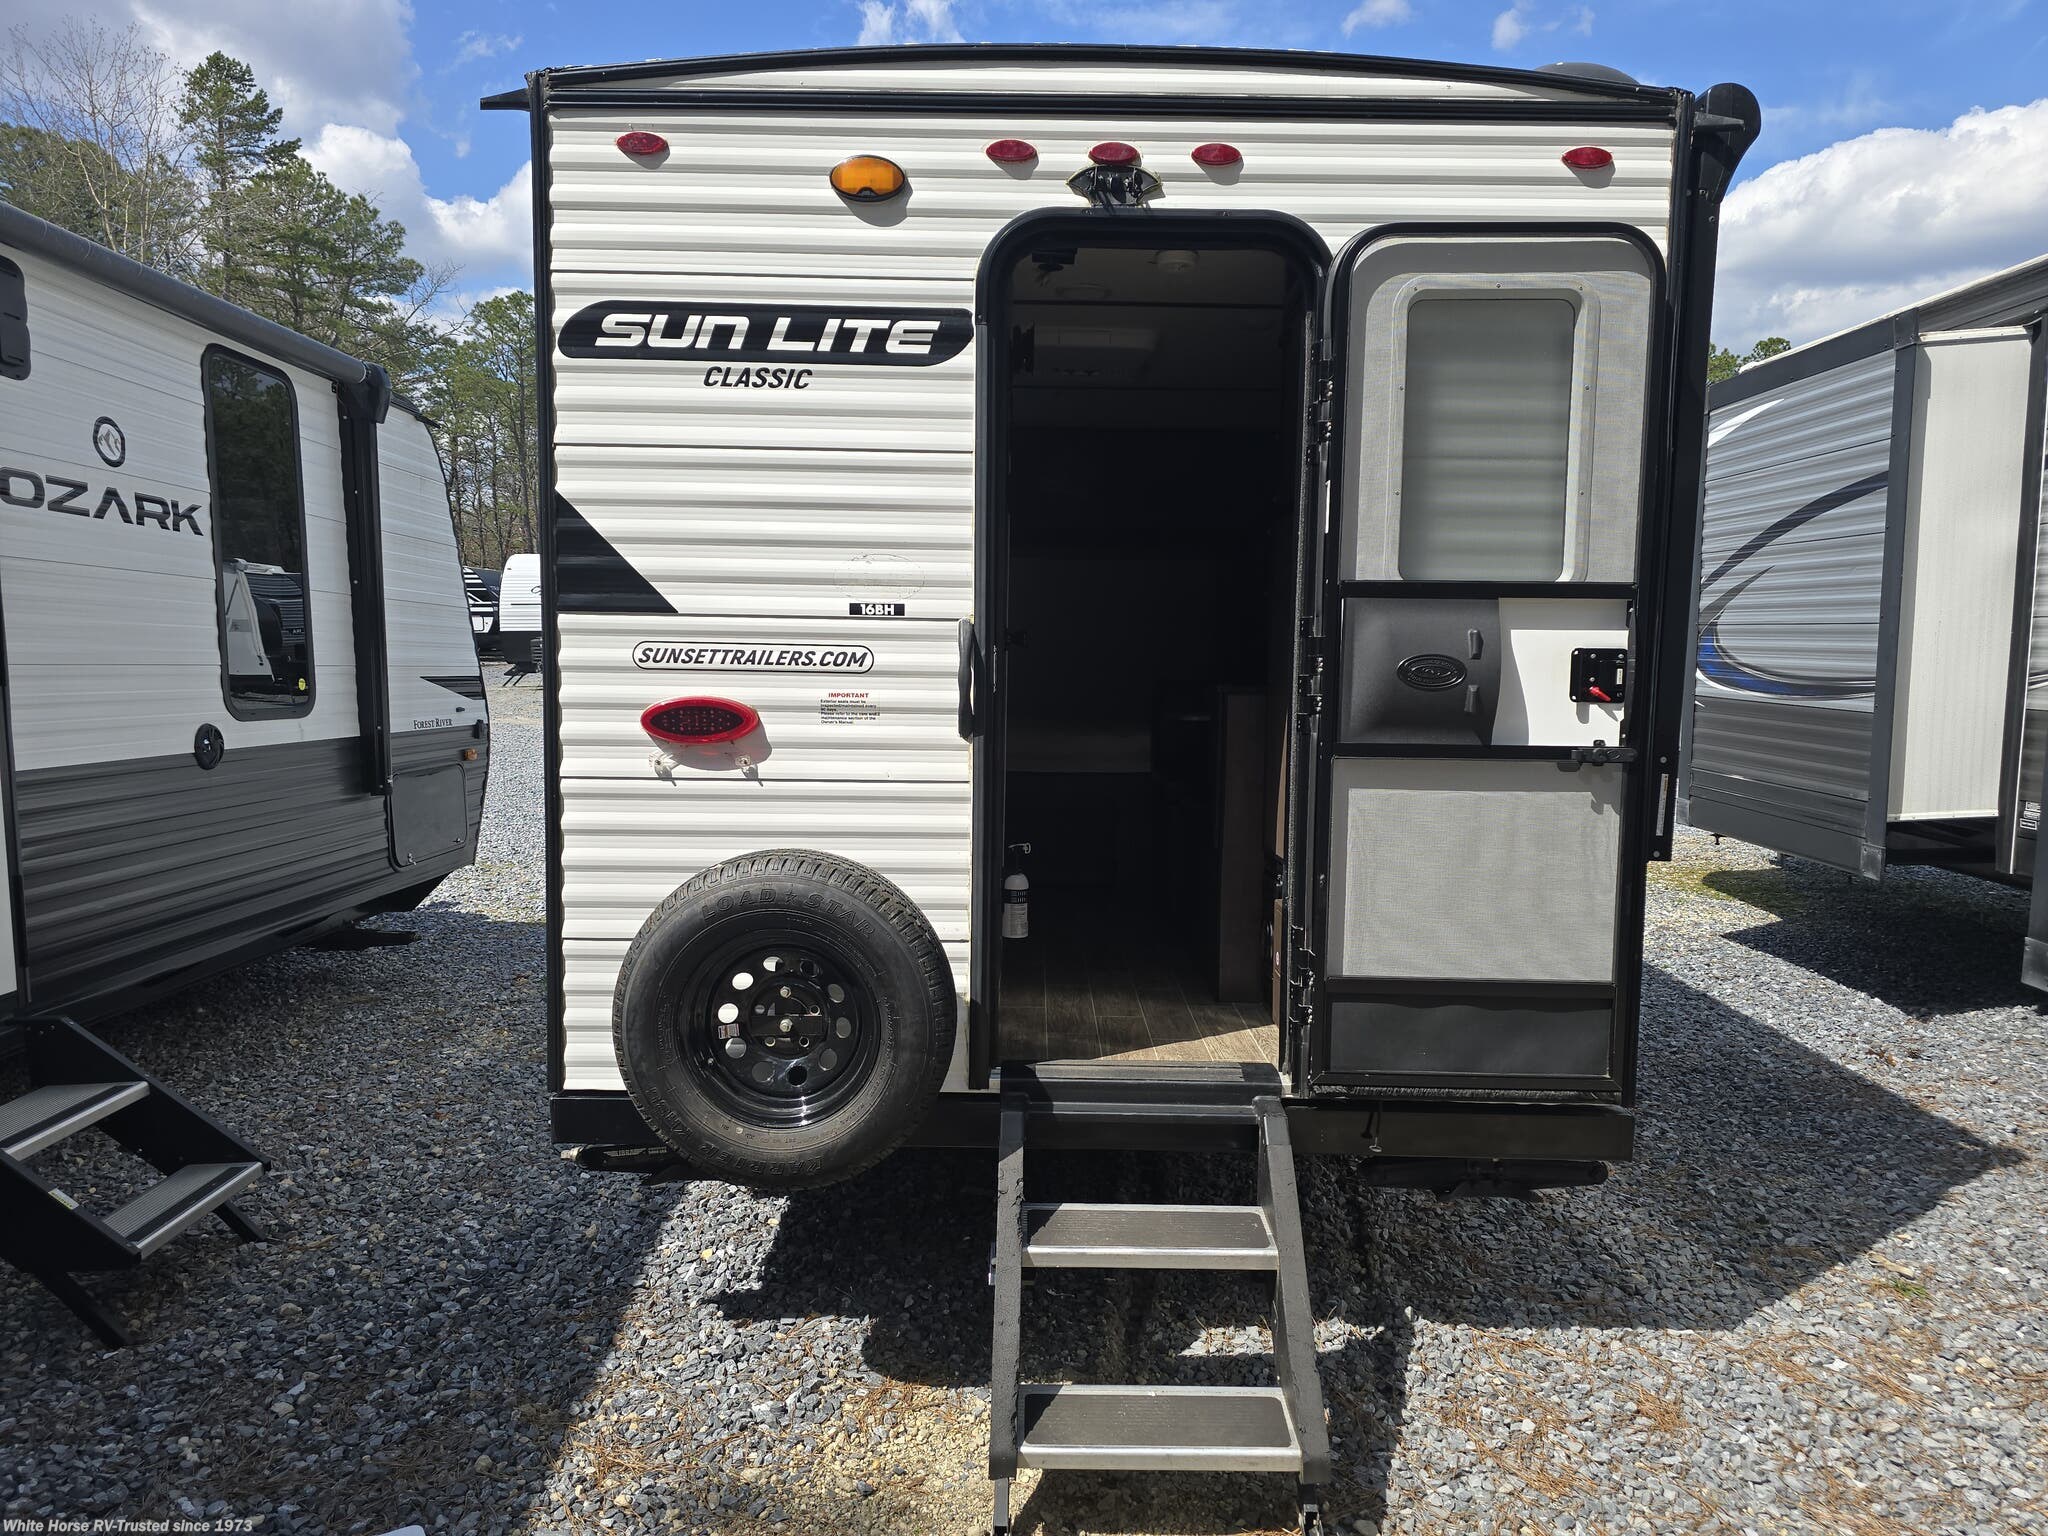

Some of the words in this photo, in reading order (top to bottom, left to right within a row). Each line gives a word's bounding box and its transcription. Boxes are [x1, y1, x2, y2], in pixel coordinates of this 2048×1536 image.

[594, 312, 750, 351] SUN
[766, 316, 941, 354] LITE
[703, 365, 813, 390] CLASSIC
[0, 466, 204, 537] OZARK
[860, 603, 895, 616] 16BH
[637, 646, 869, 669] SUNSETTRAILERS.COM
[435, 718, 452, 728] RIVER
